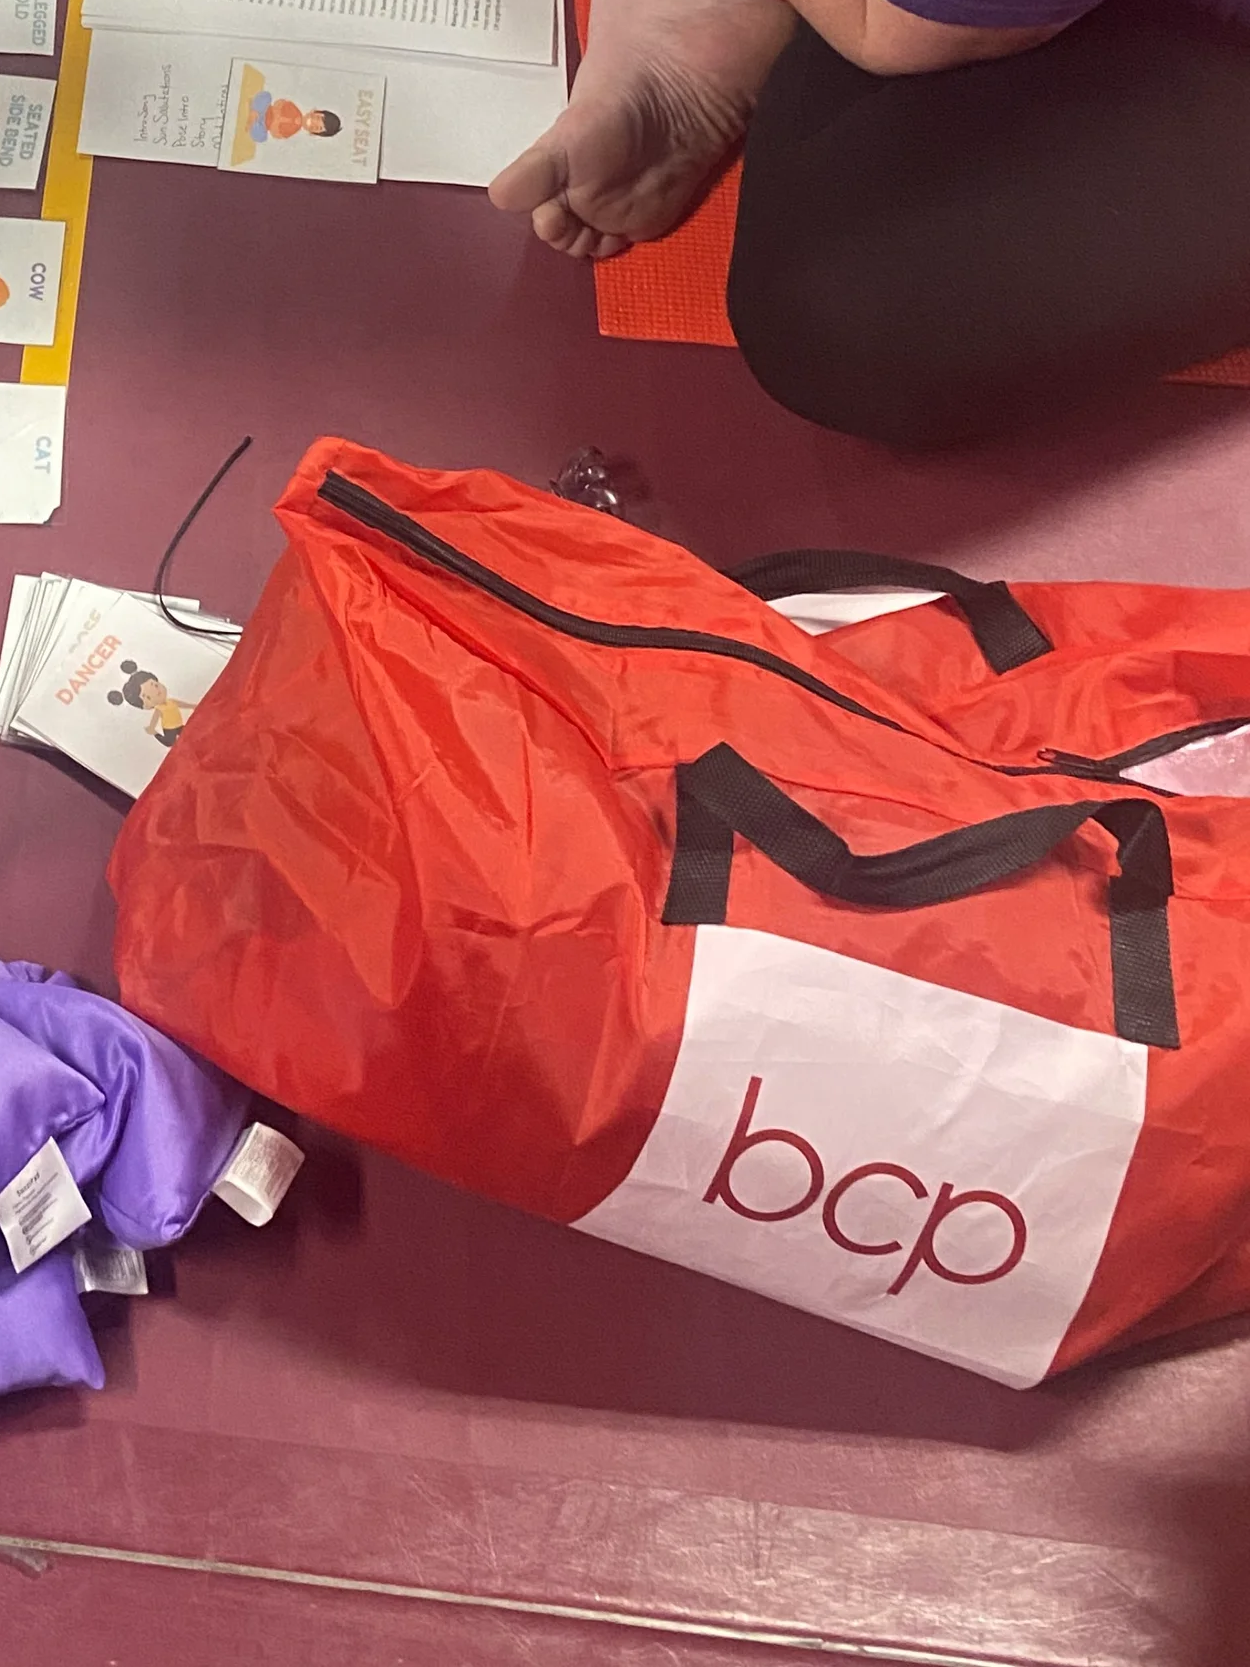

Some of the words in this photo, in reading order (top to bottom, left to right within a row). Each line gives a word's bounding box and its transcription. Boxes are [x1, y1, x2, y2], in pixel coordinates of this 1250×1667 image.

[6, 94, 26, 126] SIDE
[355, 90, 375, 127] EASY
[0, 128, 20, 167] BEND
[19, 104, 43, 160] SEATED
[352, 129, 371, 166] SEAT
[28, 262, 47, 302] COW
[33, 435, 52, 474] CAT
[54, 635, 123, 706] DANCER
[701, 1075, 1028, 1297] bcp
